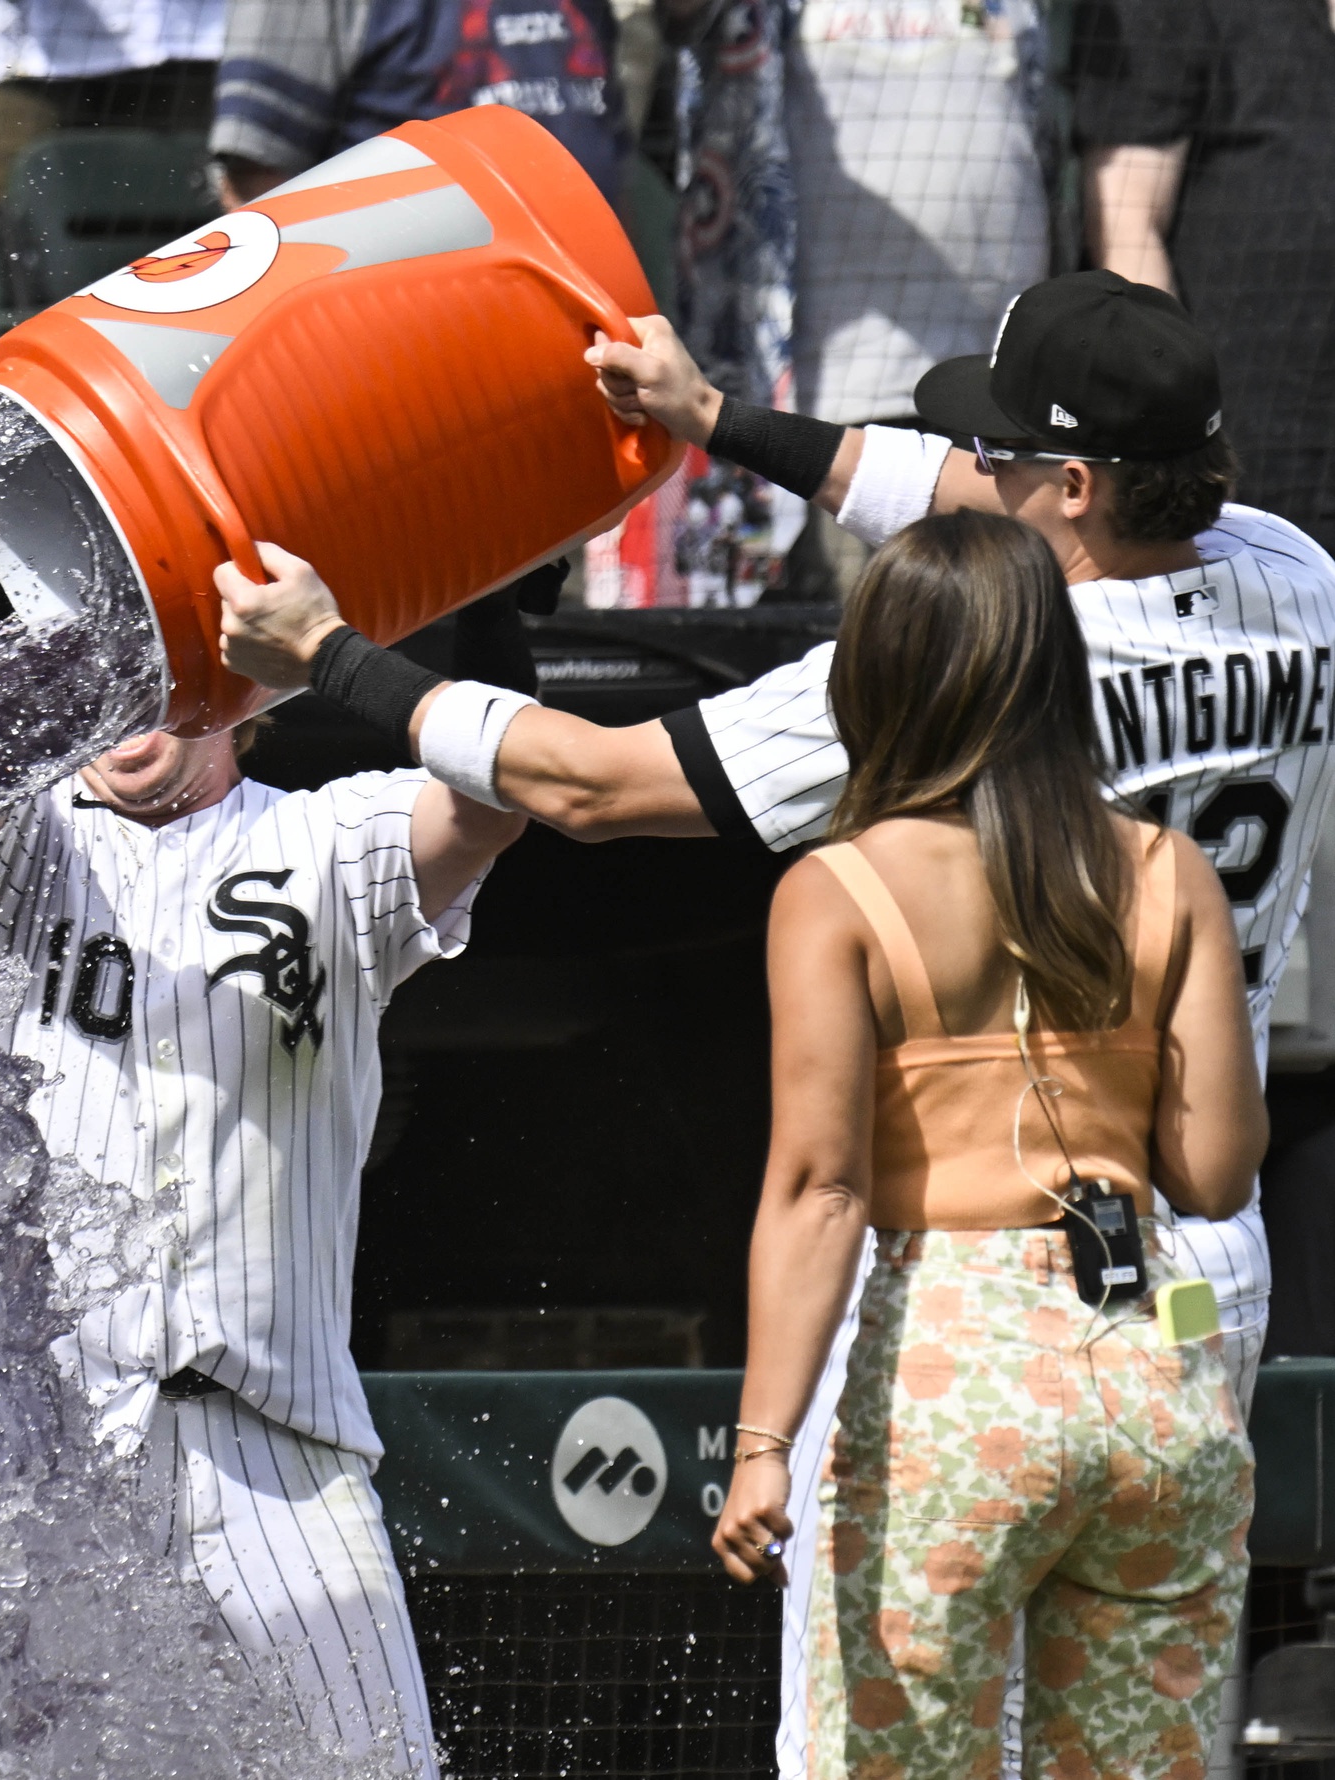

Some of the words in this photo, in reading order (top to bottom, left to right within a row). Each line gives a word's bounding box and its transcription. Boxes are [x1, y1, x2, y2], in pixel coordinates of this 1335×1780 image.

[1099, 647, 1335, 772] NTGOME
[1141, 775, 1295, 989] 2
[39, 916, 135, 1046] 10
